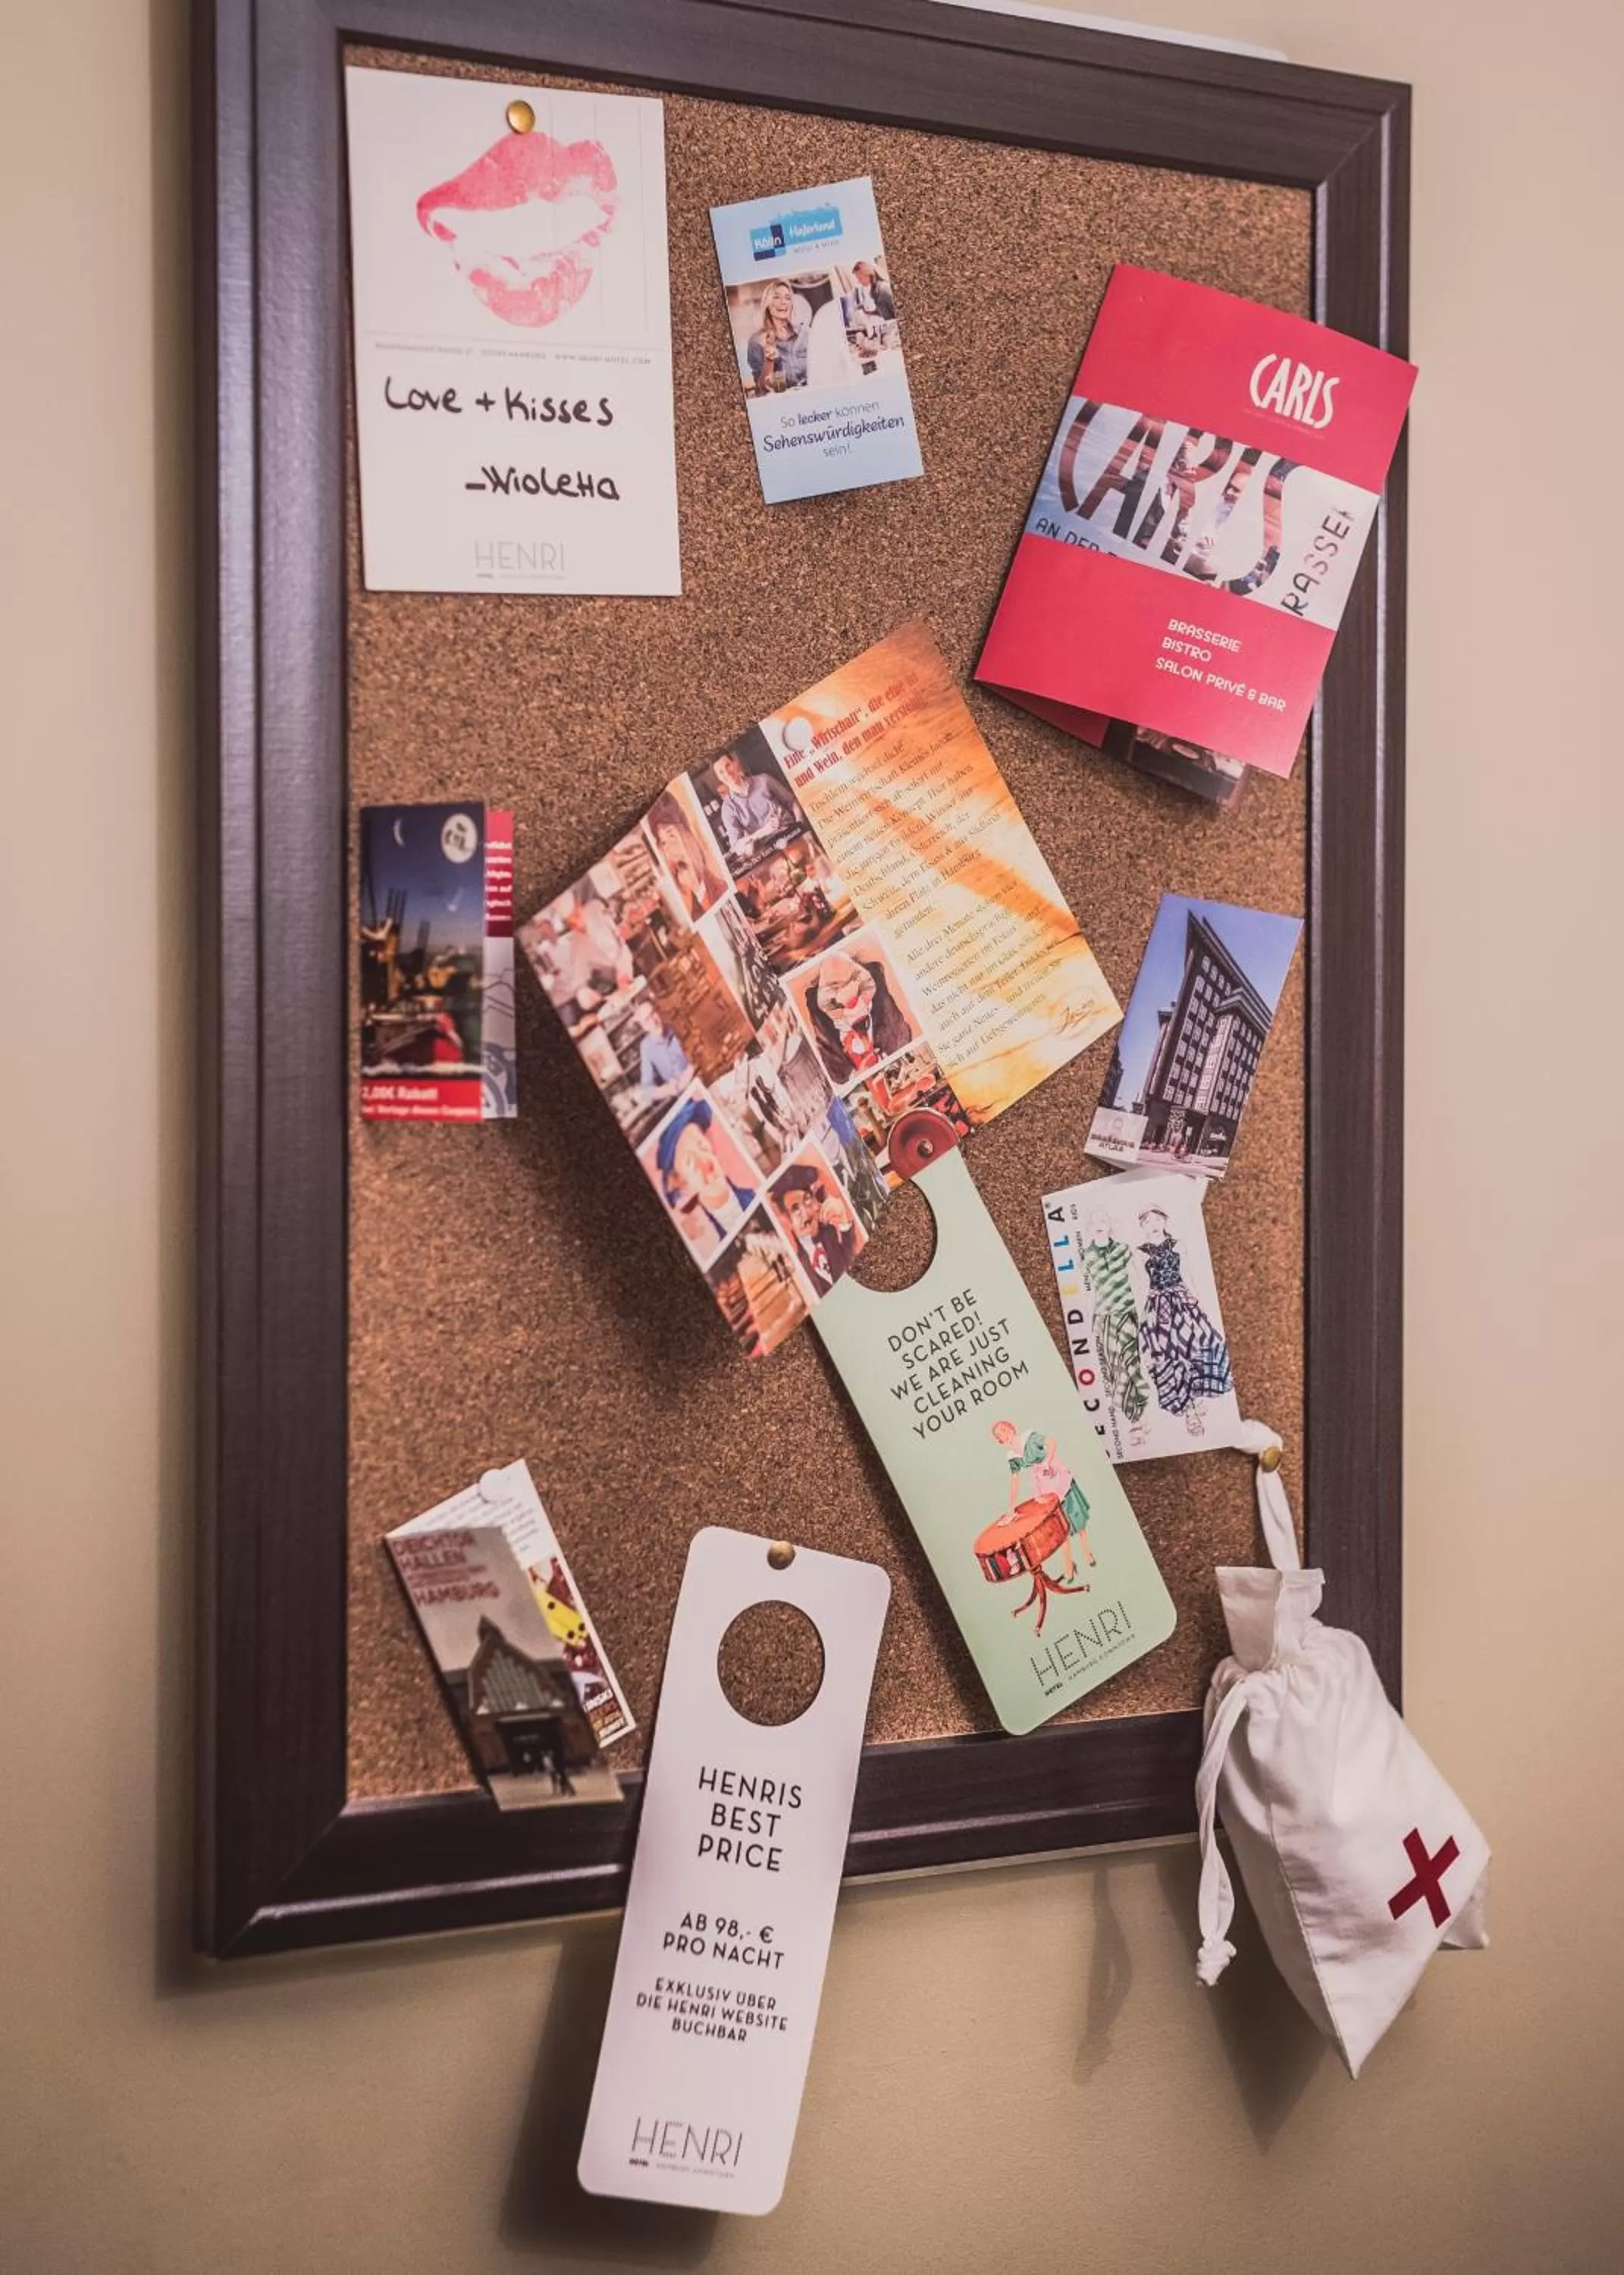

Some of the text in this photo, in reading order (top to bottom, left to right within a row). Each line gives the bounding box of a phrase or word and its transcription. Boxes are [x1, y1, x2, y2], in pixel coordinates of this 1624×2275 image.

[384, 376, 462, 413] Love
[505, 387, 614, 427] Kisses
[1249, 353, 1340, 430] CARLS
[763, 415, 905, 453] Sehenswürdigkeiten
[780, 416, 796, 428] So
[798, 410, 832, 426] lecker
[1036, 517, 1061, 538] AN
[475, 539, 565, 572] HENRI
[1162, 637, 1212, 663] BISTRO
[1168, 618, 1242, 654] BRASSERIE
[1155, 657, 1203, 683] SALON
[1205, 673, 1246, 697] PRIVÉ
[1258, 690, 1287, 713] BAR
[793, 766, 814, 787] und
[814, 748, 842, 774] Wein,
[841, 735, 861, 755] den
[861, 721, 884, 742] man
[887, 1288, 977, 1353] DON'T BE
[901, 1311, 983, 1369] SCARED!
[1047, 1205, 1111, 1459] ECONDELLA
[890, 1318, 1010, 1401] WE ARE JUST
[914, 1346, 1010, 1414] CLEANING
[913, 1360, 1029, 1439] YOUR ROOM
[1030, 1601, 1132, 1687] HENRI
[698, 1766, 802, 1809] HENRIS
[710, 1803, 781, 1838] BEST
[698, 1834, 783, 1872] PRICE
[680, 1912, 707, 1932] AB
[759, 1925, 774, 1945] €
[663, 1931, 785, 1970] PRO NACHT
[655, 1976, 732, 2004] EXKLUSIV
[636, 1992, 788, 2032] DIE HENRI WEBSITE
[672, 2017, 748, 2043] BUCHBAR
[631, 2117, 744, 2167] HENRI
